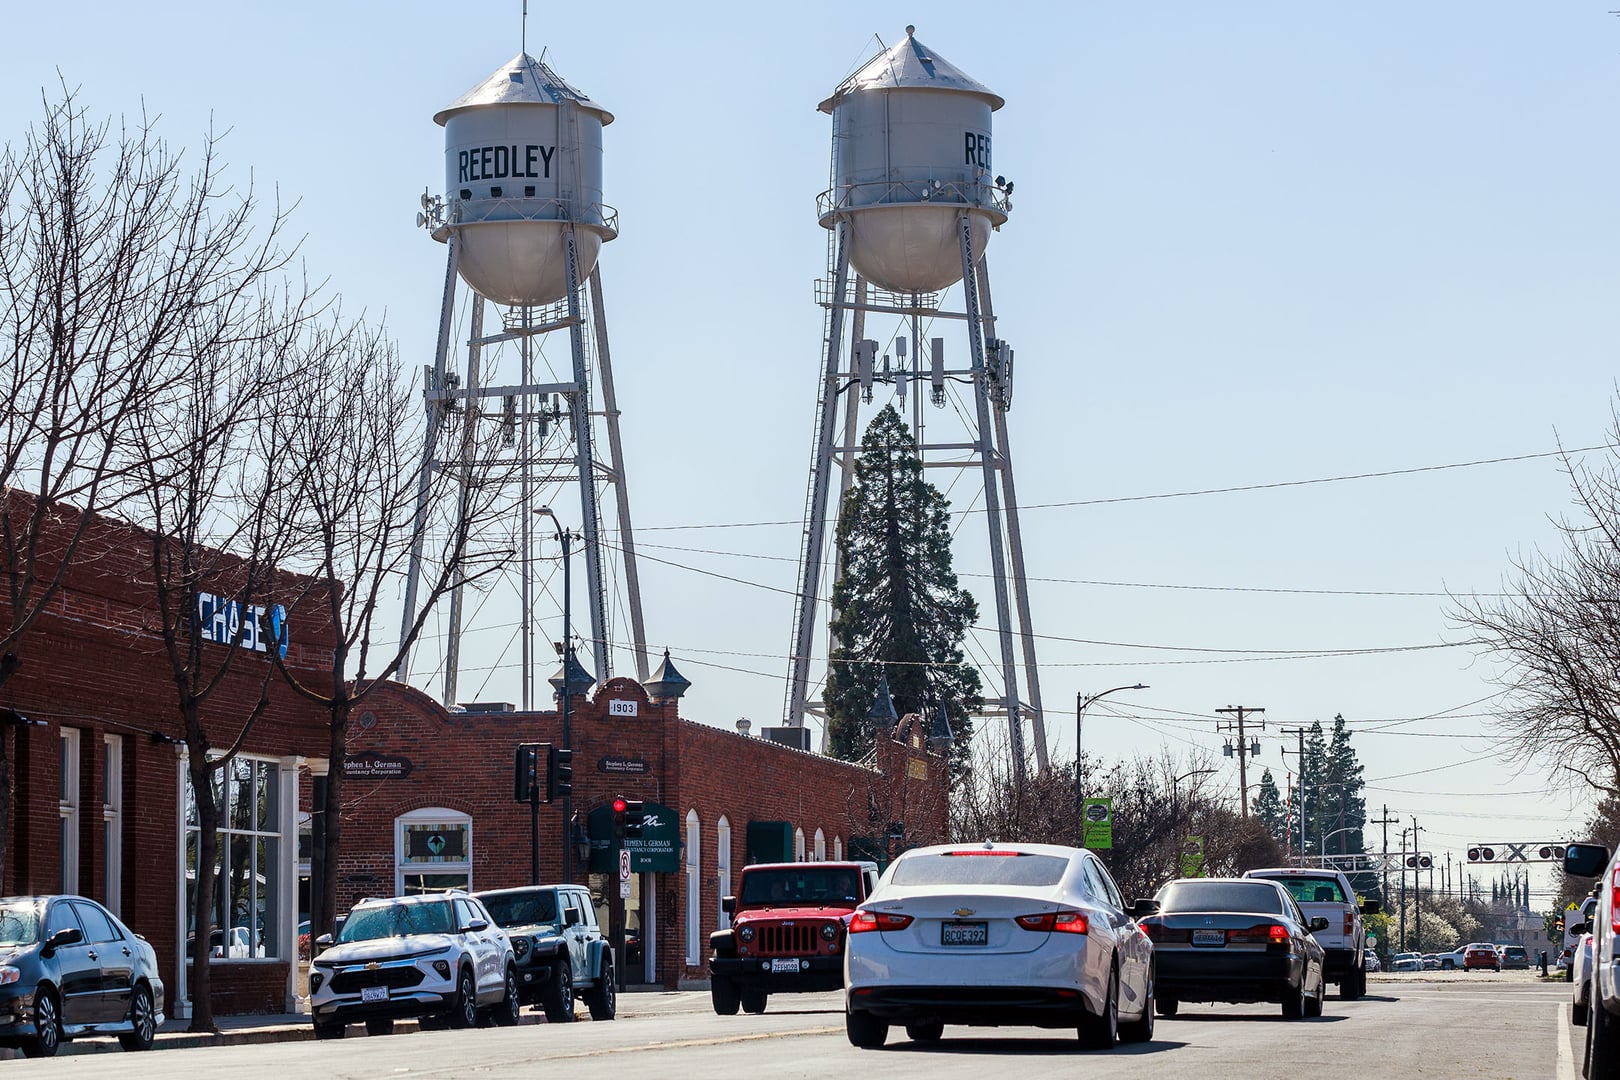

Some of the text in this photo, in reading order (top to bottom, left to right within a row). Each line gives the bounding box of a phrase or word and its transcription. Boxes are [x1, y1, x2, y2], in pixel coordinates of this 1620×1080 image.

[459, 145, 555, 183] REEDLEY
[199, 592, 268, 652] CHASE
[613, 704, 634, 712] 1903
[374, 760, 402, 768] German
